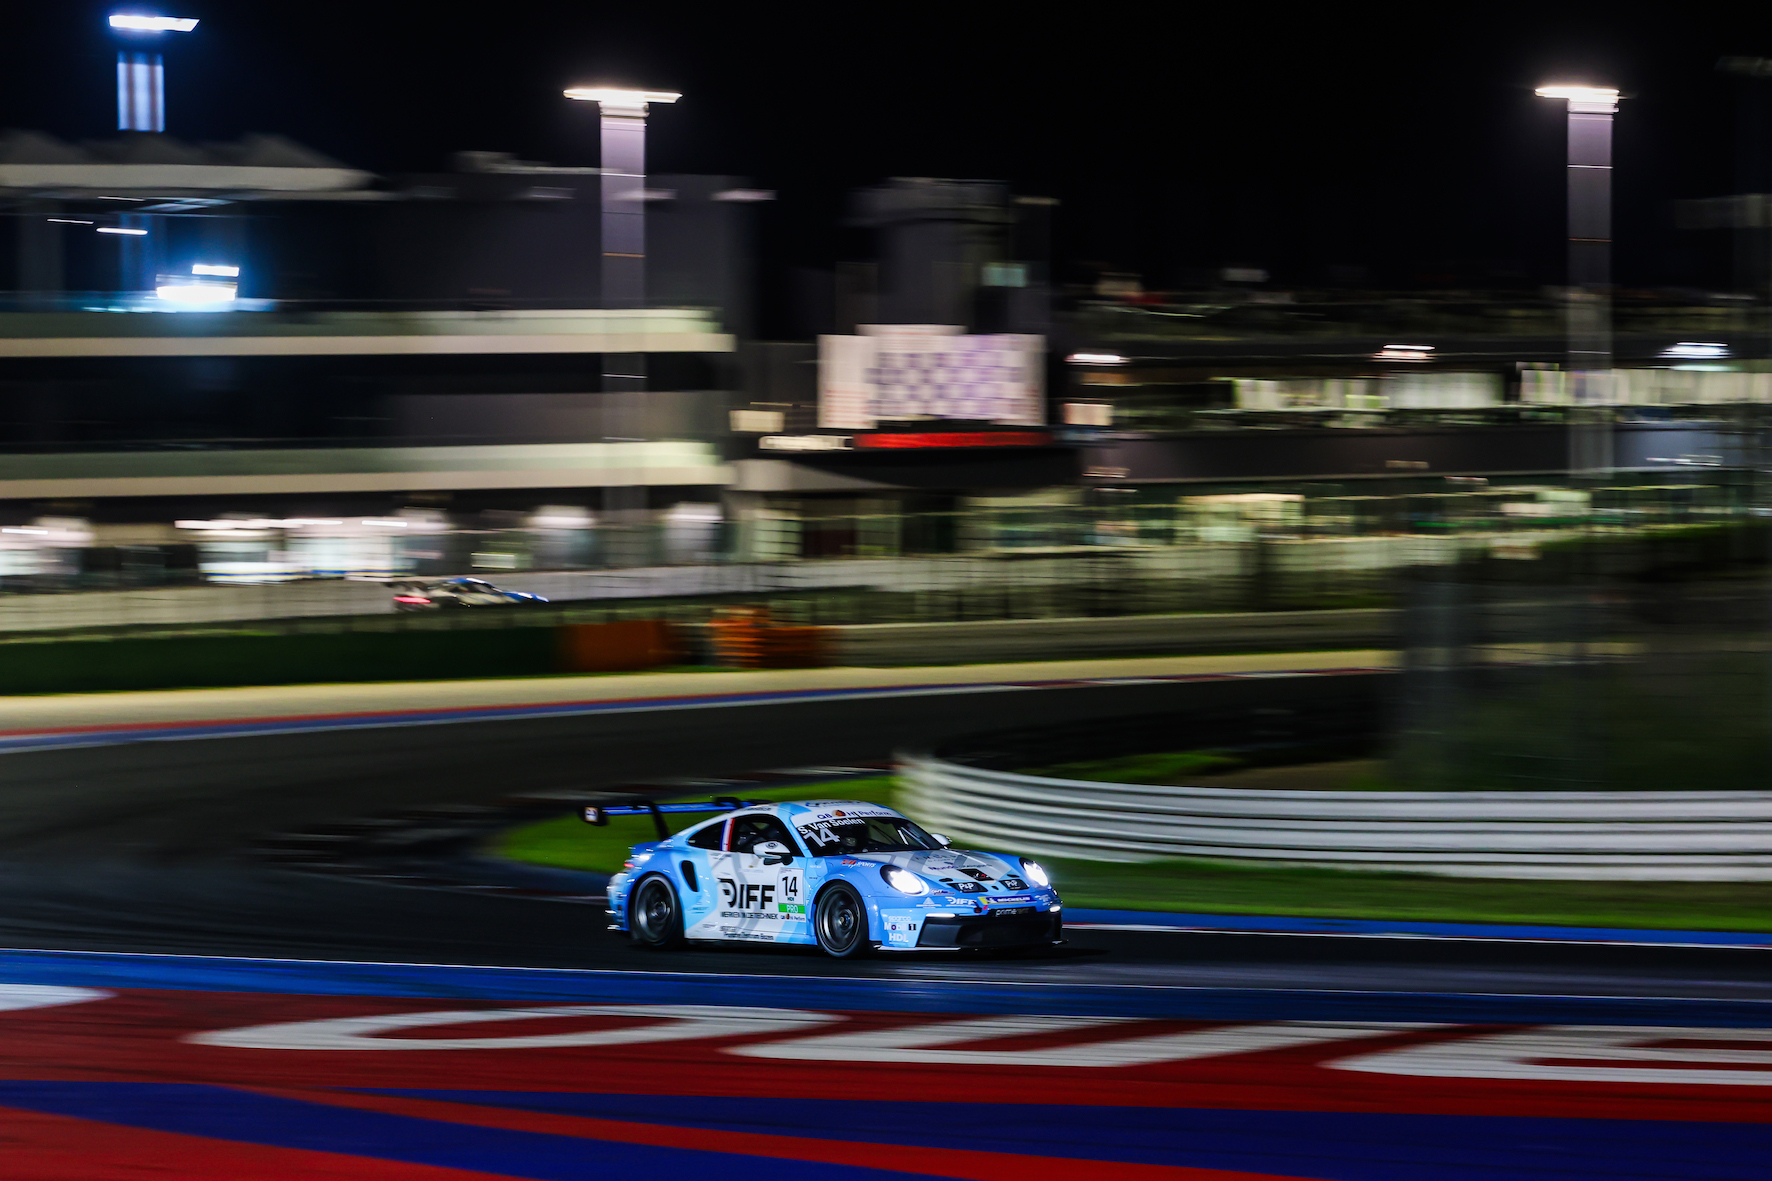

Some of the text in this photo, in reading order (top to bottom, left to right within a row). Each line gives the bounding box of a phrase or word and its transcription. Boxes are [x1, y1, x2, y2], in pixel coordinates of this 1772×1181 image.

[798, 817, 866, 834] S. Van Soelen
[803, 828, 840, 848] 14
[781, 876, 798, 897] 14
[786, 904, 798, 913] PRO
[884, 922, 906, 931] Mobil
